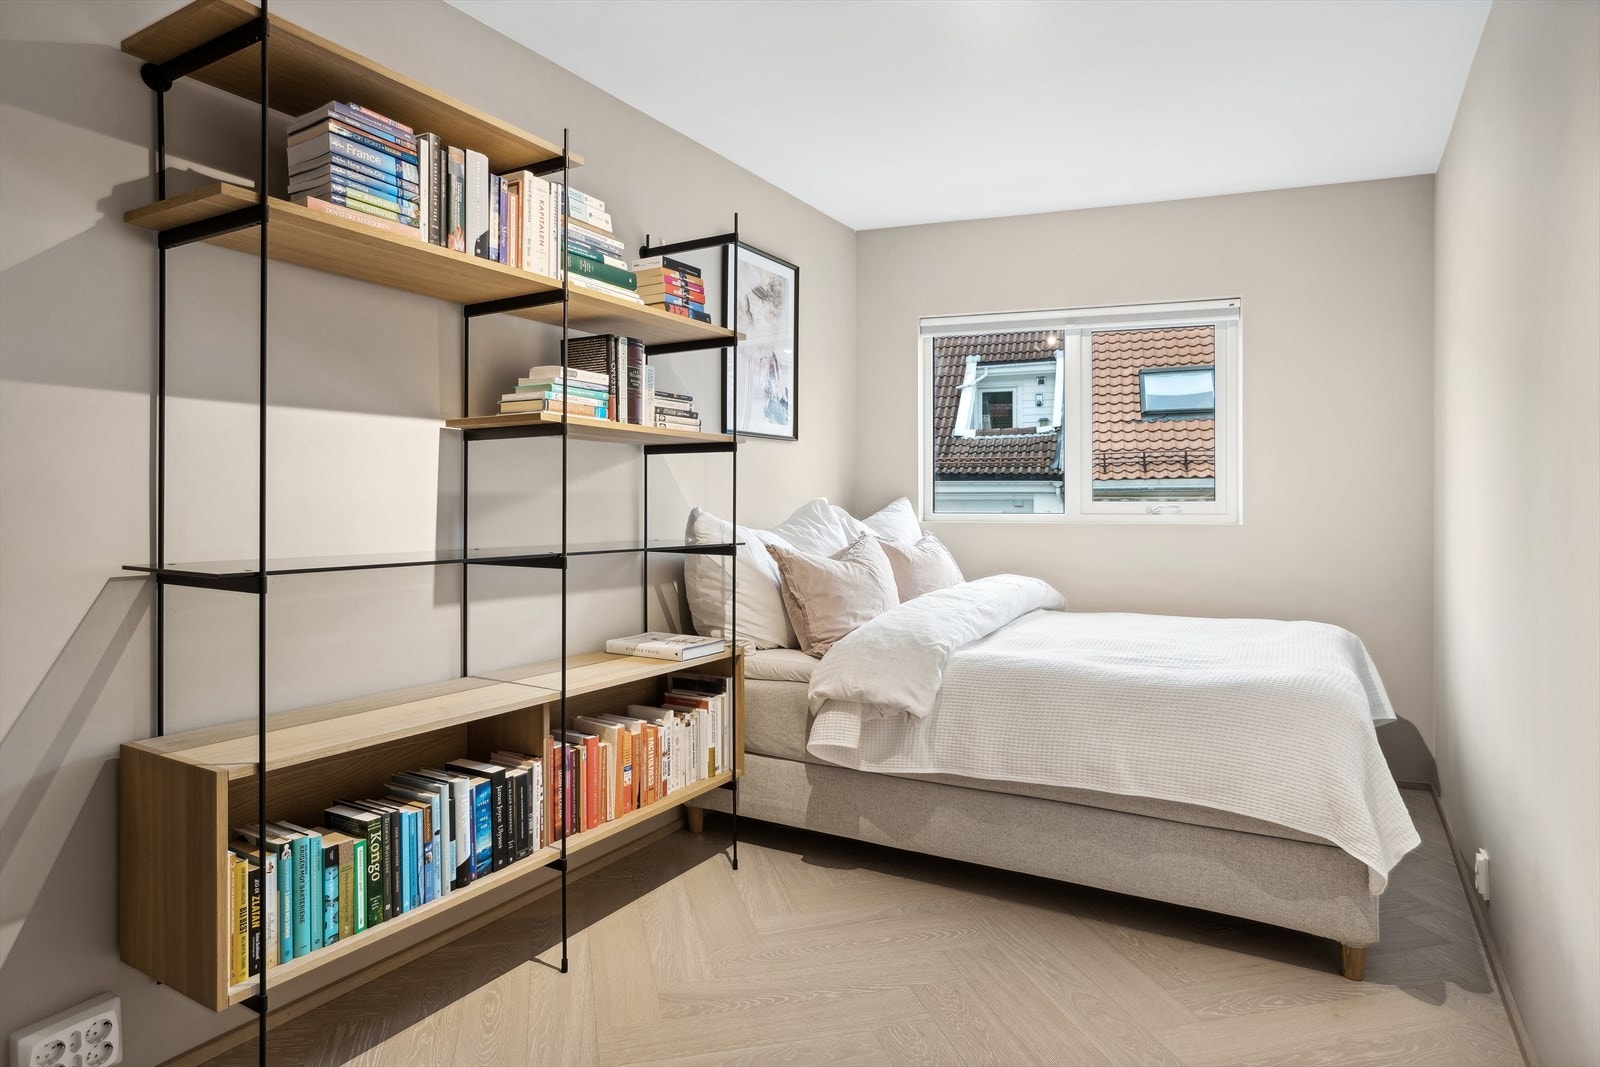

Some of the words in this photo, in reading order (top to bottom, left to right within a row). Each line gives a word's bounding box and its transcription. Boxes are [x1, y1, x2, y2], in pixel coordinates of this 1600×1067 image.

[346, 143, 381, 164] France
[347, 160, 360, 171] New
[360, 164, 375, 174] York
[374, 169, 386, 180] City
[325, 207, 338, 217] DEN
[361, 204, 397, 220] California
[496, 785, 504, 805] James
[496, 805, 504, 823] Joyce
[496, 824, 504, 849] Ulysses
[367, 830, 382, 882] Kongo
[239, 906, 248, 918] BLI
[251, 895, 260, 929] ZLATAN
[239, 918, 248, 935] BEST
